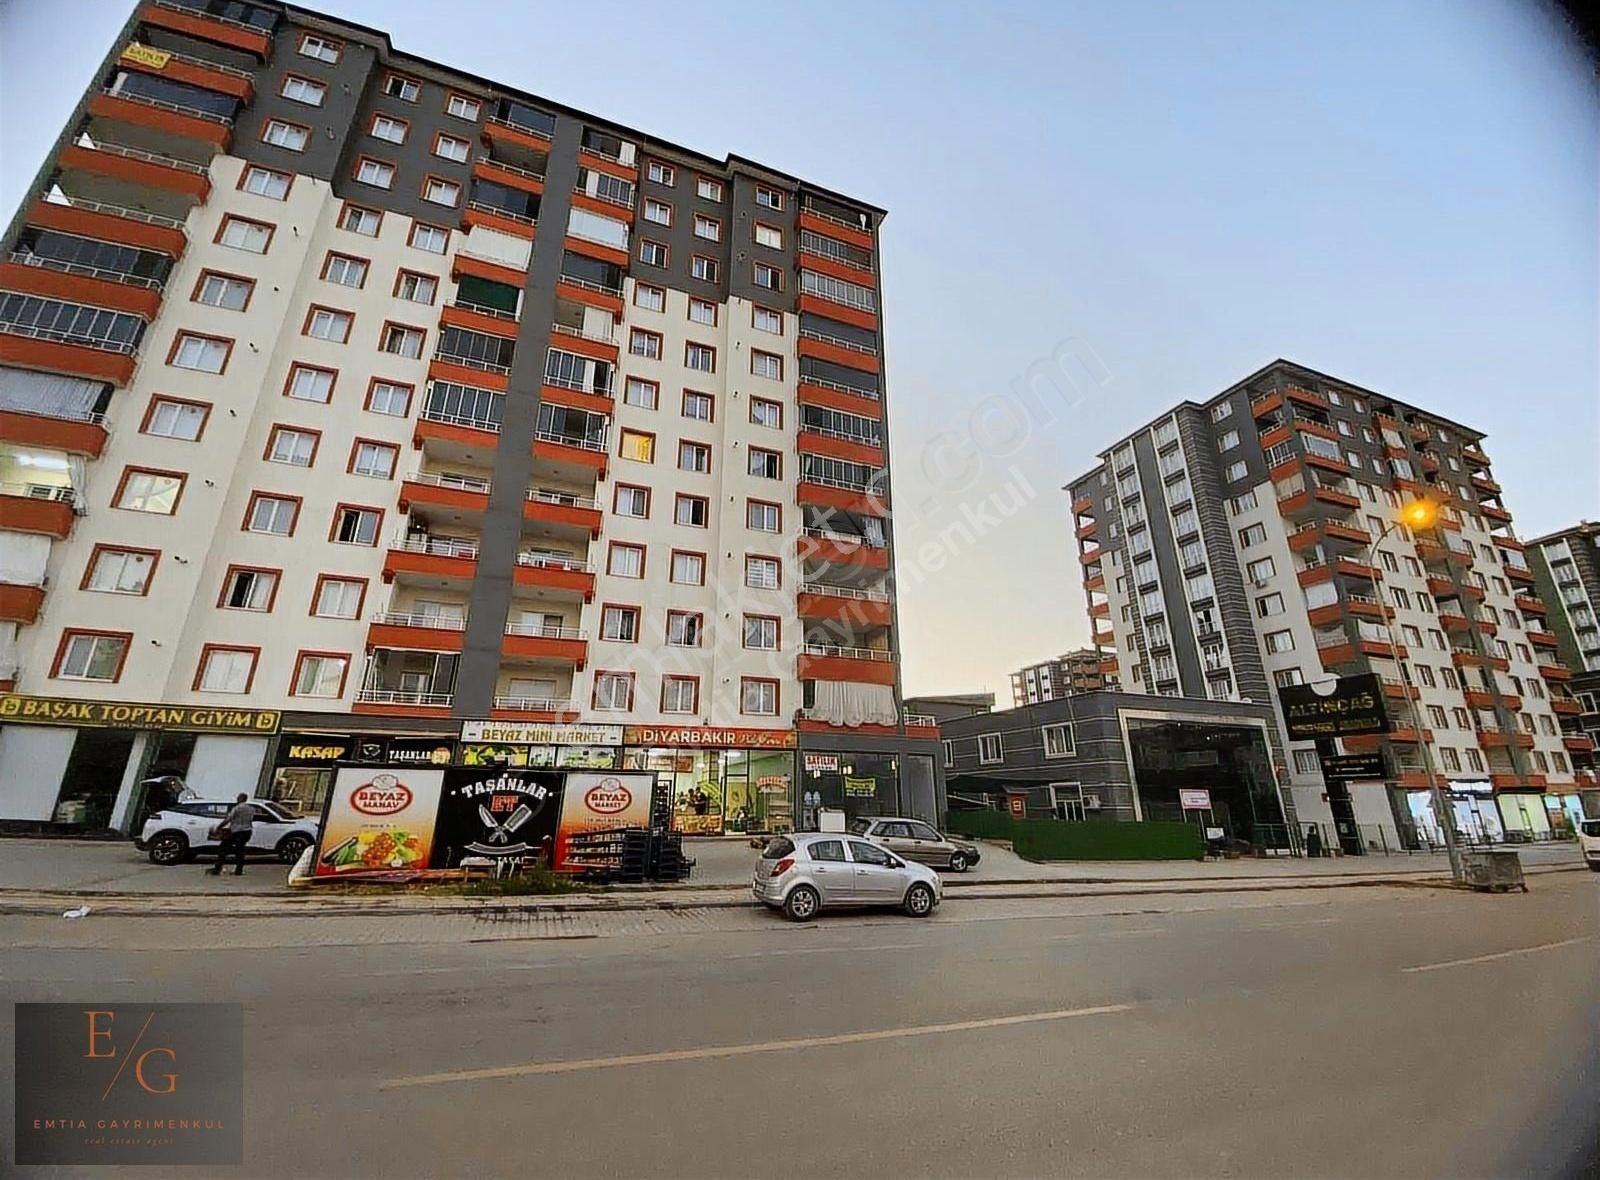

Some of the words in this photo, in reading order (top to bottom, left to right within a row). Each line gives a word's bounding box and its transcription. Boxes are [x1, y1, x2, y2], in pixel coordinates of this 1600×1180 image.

[22, 700, 95, 719] BAŞAK
[101, 705, 185, 724] TOPTAN
[481, 728, 522, 741] BEYAZ
[556, 730, 606, 743] MARKET
[289, 745, 345, 759] KASAP
[359, 791, 406, 801] BEYAZ
[461, 777, 547, 800] TAŞANLAR
[490, 794, 519, 812] ET
[591, 793, 627, 802] BEYAZ
